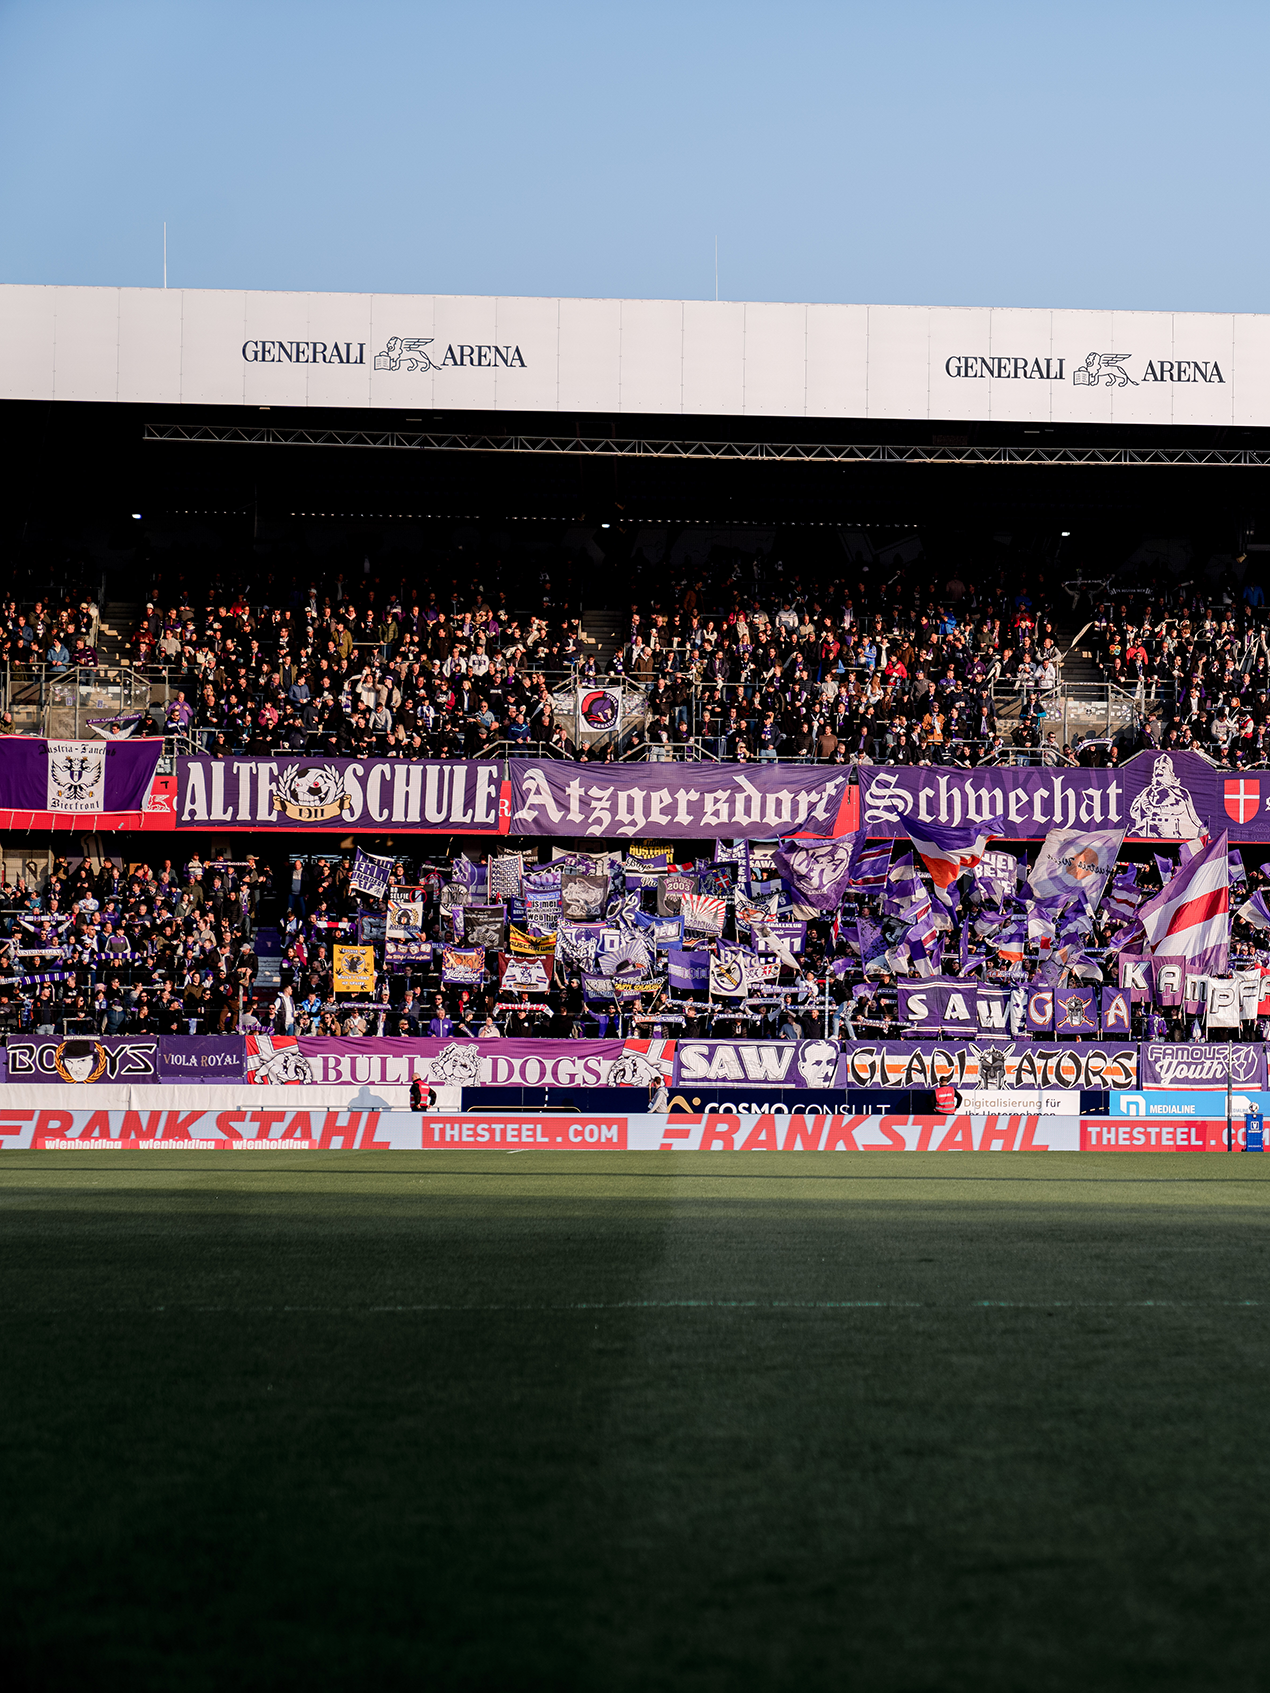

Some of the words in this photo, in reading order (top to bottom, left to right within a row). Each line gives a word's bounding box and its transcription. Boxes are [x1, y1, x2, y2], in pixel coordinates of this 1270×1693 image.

[241, 340, 366, 365] GENERALI
[441, 344, 527, 368] ARENA
[945, 356, 1066, 380] GENERALI
[1141, 359, 1226, 384] ARENA
[181, 761, 279, 821] ALTE
[342, 763, 498, 823] SCHULE
[50, 798, 100, 810] Bierfront
[513, 768, 847, 836] Atzgersdorf
[864, 773, 1123, 830] Schwechat
[298, 807, 325, 818] 1911
[755, 936, 803, 951] 111
[163, 1053, 198, 1067] VIOLA
[201, 1053, 240, 1067] ROYAL
[1148, 1045, 1229, 1062] FAMOUS
[317, 1055, 429, 1085] BULL
[486, 1055, 603, 1087] DOGS
[679, 1045, 795, 1081] SAW
[850, 1046, 1138, 1090] GLADIATORS
[1156, 1059, 1229, 1084] Youth
[704, 1102, 788, 1115] COSMO
[792, 1104, 890, 1115] CONSULT
[963, 1098, 1042, 1110] Digitalisierung
[1045, 1098, 1061, 1108] für
[1150, 1105, 1195, 1114] MEDIALINE
[45, 1139, 122, 1150] wienholding
[139, 1139, 216, 1150] wienholding
[232, 1139, 309, 1150] wienholding
